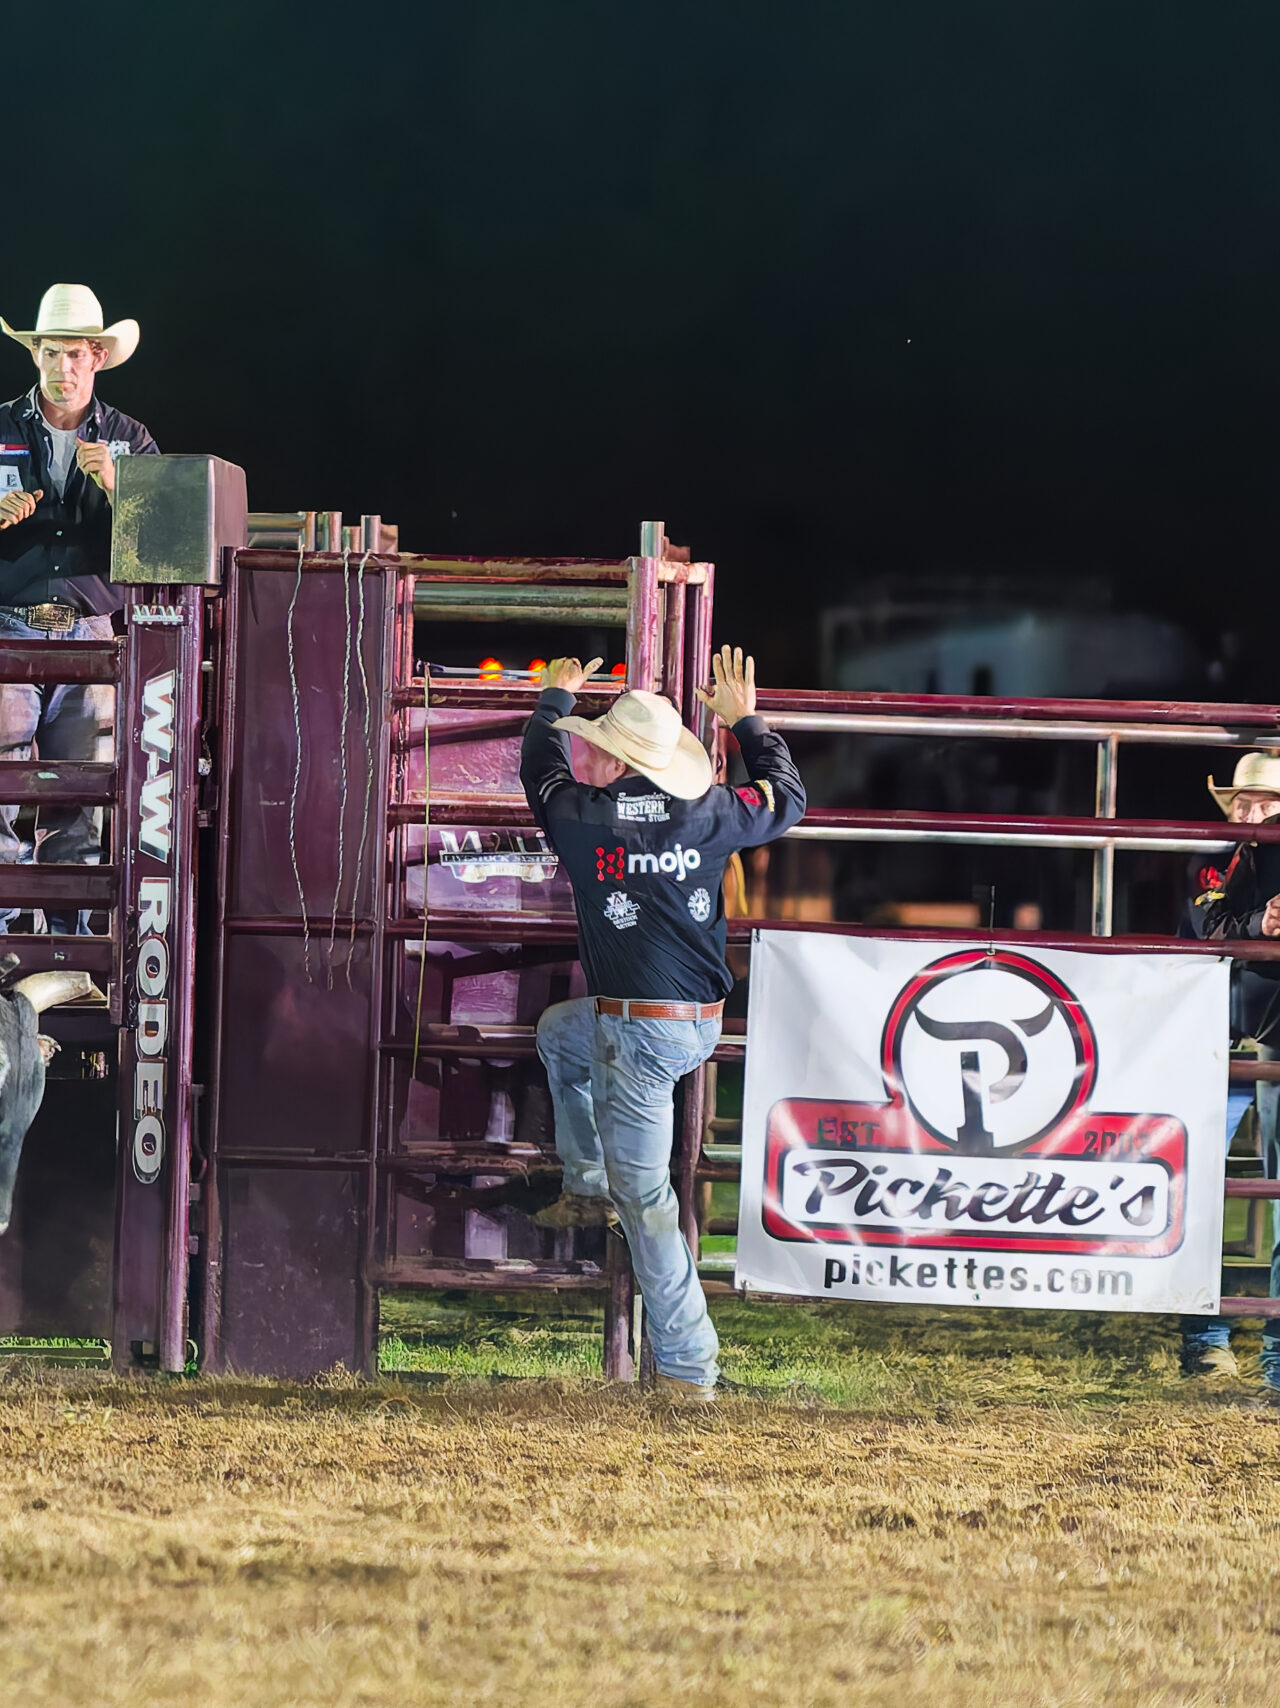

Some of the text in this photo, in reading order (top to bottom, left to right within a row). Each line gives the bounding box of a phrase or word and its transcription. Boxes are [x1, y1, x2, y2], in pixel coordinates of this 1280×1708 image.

[617, 800, 665, 816] WESTERN
[628, 843, 701, 881] mojo
[132, 670, 175, 1185] W-W RODEO
[792, 1158, 1156, 1227] Pickette's
[823, 1253, 1134, 1296] pickettes.com
